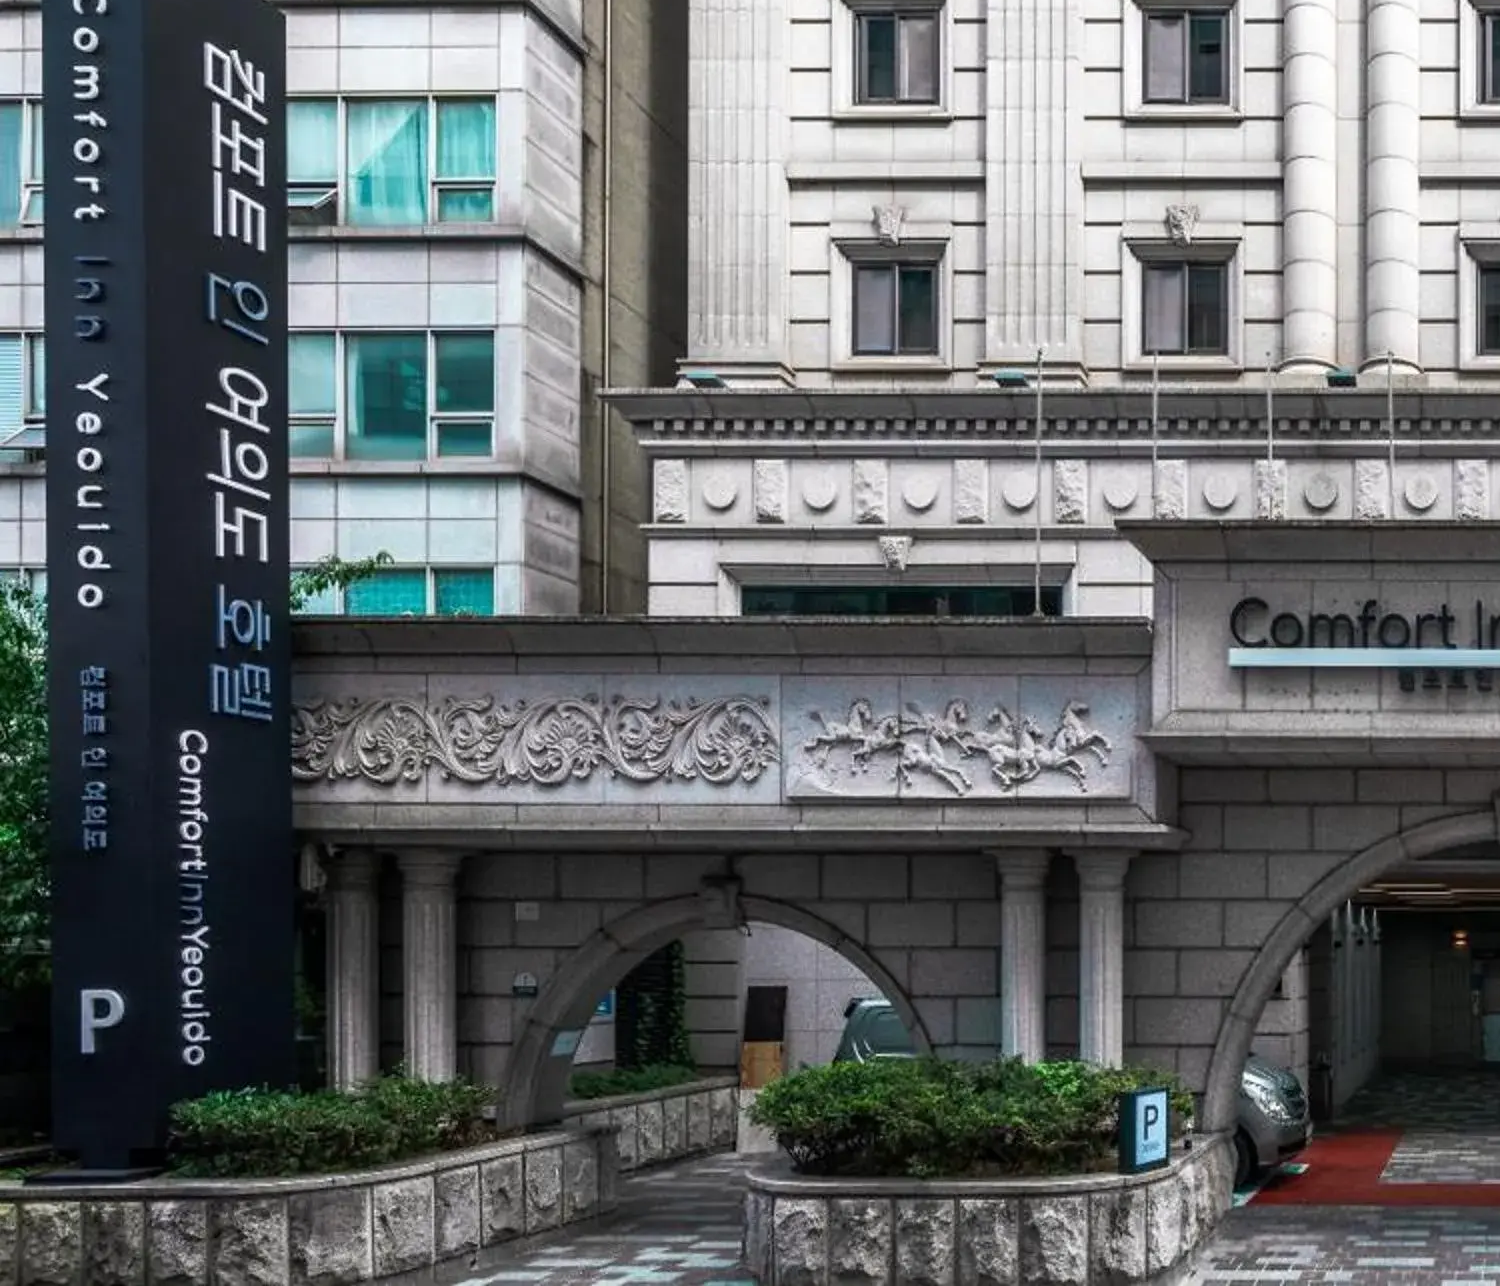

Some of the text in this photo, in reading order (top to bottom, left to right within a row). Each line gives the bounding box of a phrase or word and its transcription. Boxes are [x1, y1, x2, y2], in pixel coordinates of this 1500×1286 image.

[75, 255, 109, 340] Inn
[203, 41, 273, 722] 컴포트 인 여의도 호텔
[75, 372, 111, 608] Yeouido
[1230, 597, 1457, 648] Comfort
[81, 665, 107, 850] 컴포트 인 여의도
[80, 988, 125, 1054] P
[1143, 1104, 1159, 1141] P
